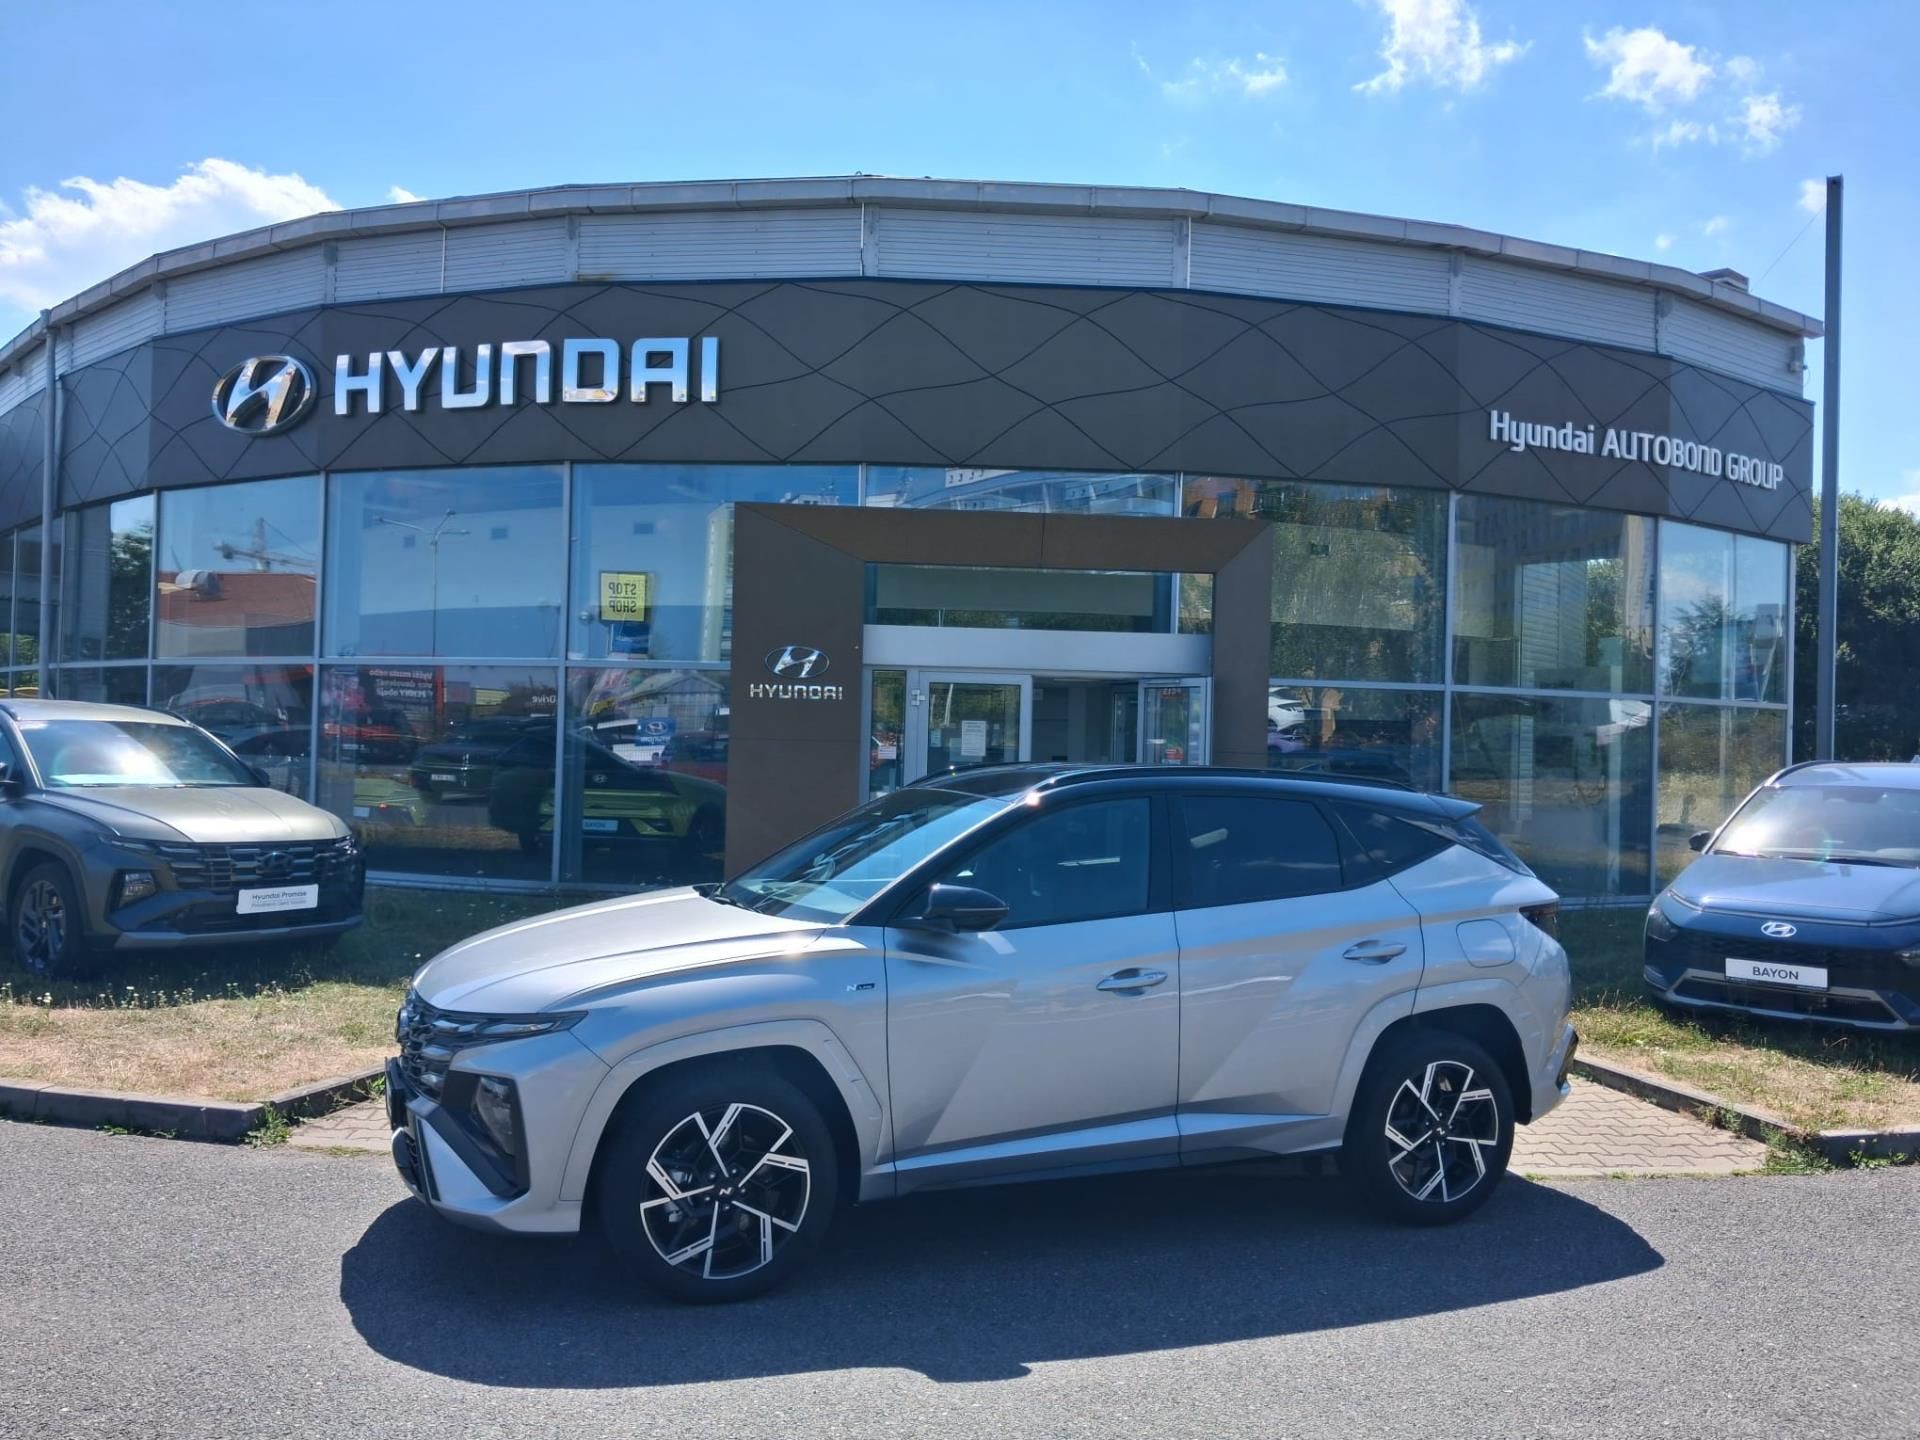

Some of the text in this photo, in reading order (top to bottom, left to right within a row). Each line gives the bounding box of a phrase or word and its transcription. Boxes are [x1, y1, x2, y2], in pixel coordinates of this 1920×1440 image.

[334, 337, 719, 415] HYUNDAI
[1490, 410, 1783, 490] Hyundai AUTOBOND GROUP
[750, 683, 843, 700] HYUNDAI
[1752, 966, 1799, 980] BAYON
